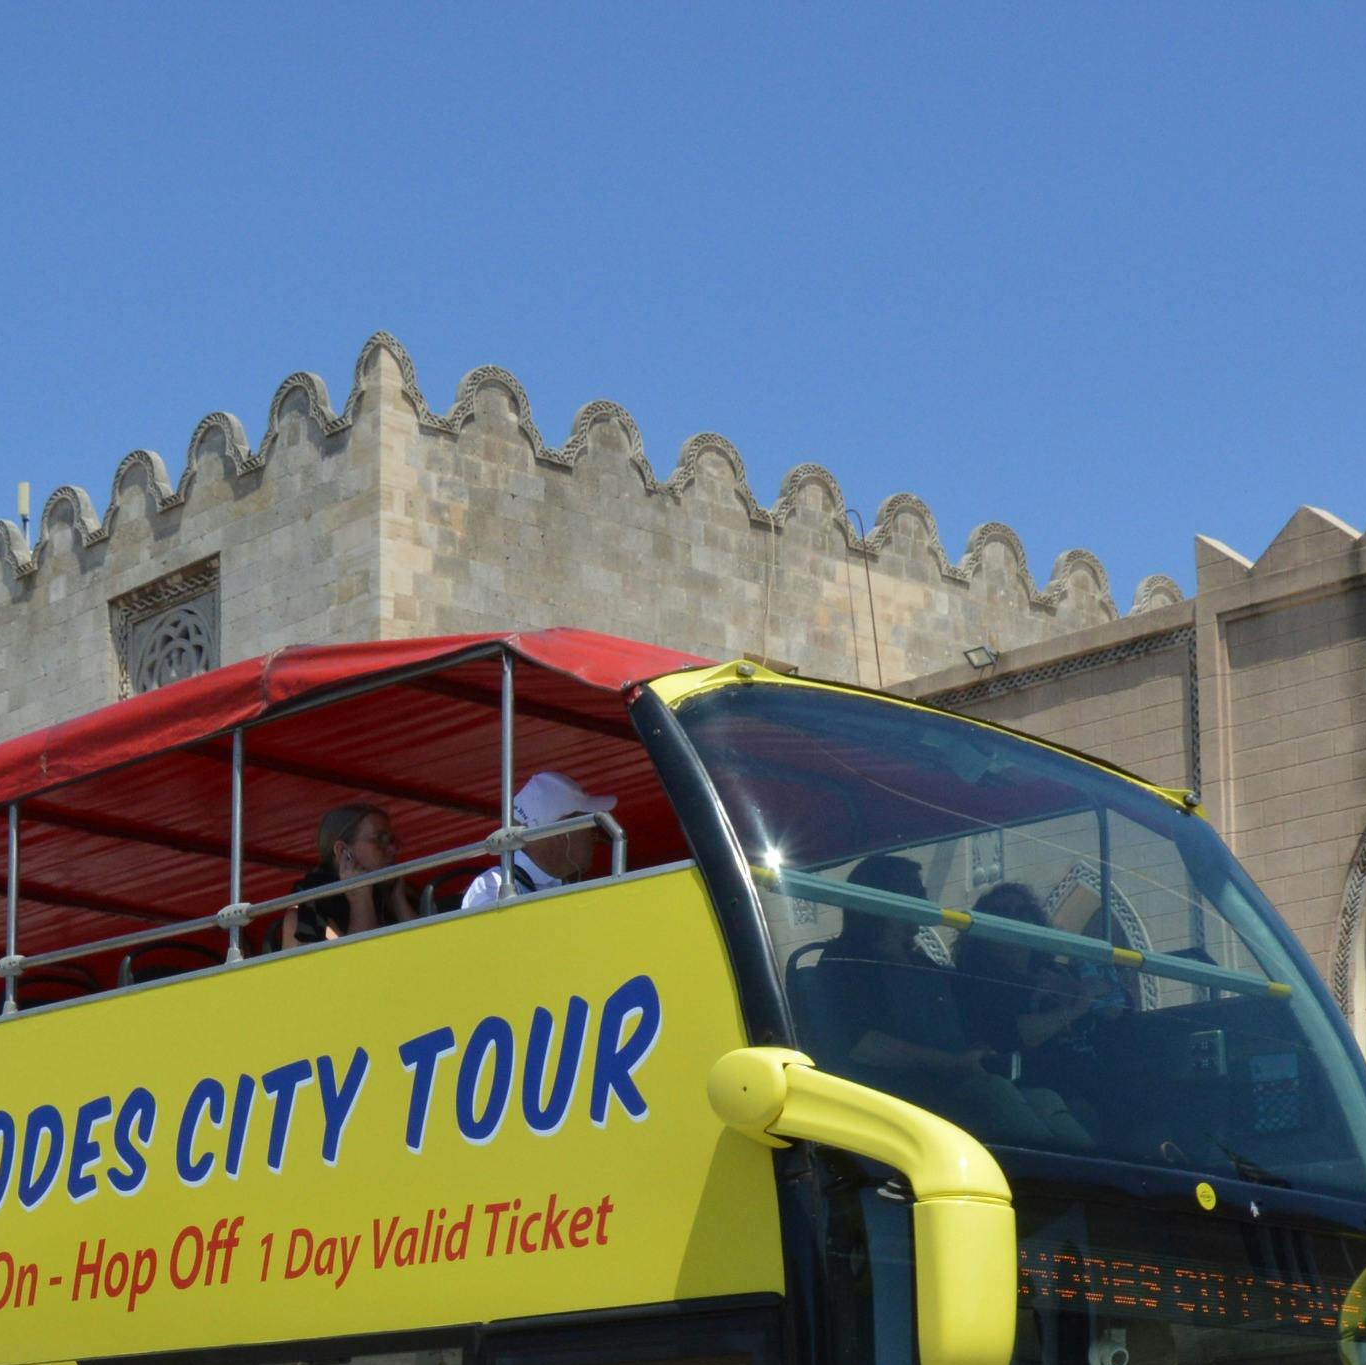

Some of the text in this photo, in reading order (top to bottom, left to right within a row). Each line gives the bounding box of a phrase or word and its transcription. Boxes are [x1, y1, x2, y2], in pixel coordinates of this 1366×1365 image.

[176, 1046, 369, 1187] CITY
[398, 974, 662, 1155] TOUR
[71, 1238, 157, 1313] Hop
[169, 1216, 245, 1290] Off
[260, 1232, 274, 1282] 1
[284, 1228, 361, 1290] Day
[372, 1204, 474, 1270] Valid
[484, 1193, 614, 1257] Ticket
[1018, 1250, 1162, 1307] HODES
